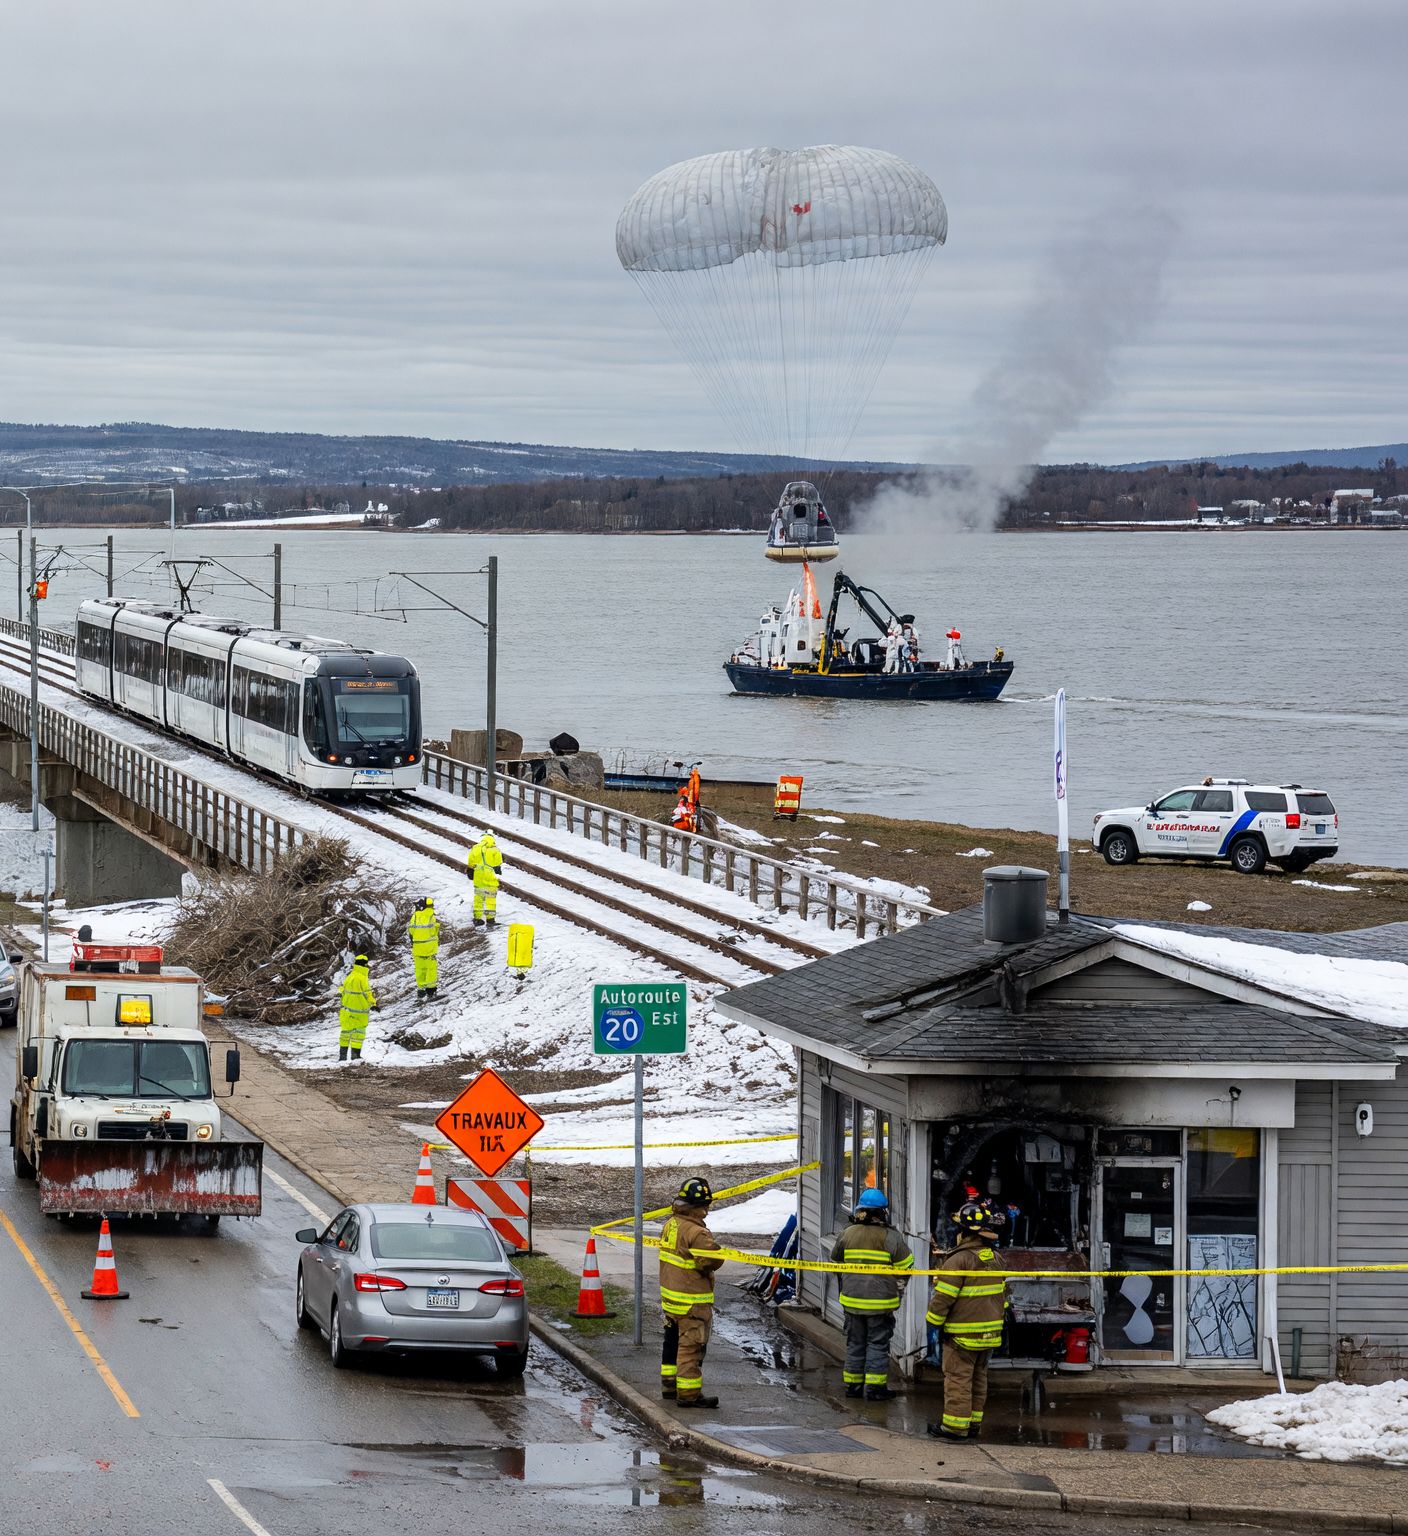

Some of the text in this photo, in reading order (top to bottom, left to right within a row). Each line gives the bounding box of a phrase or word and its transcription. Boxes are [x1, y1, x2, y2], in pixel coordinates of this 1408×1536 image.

[605, 1011, 679, 1042] 20 Est
[450, 1111, 527, 1130] TRAVAUX
